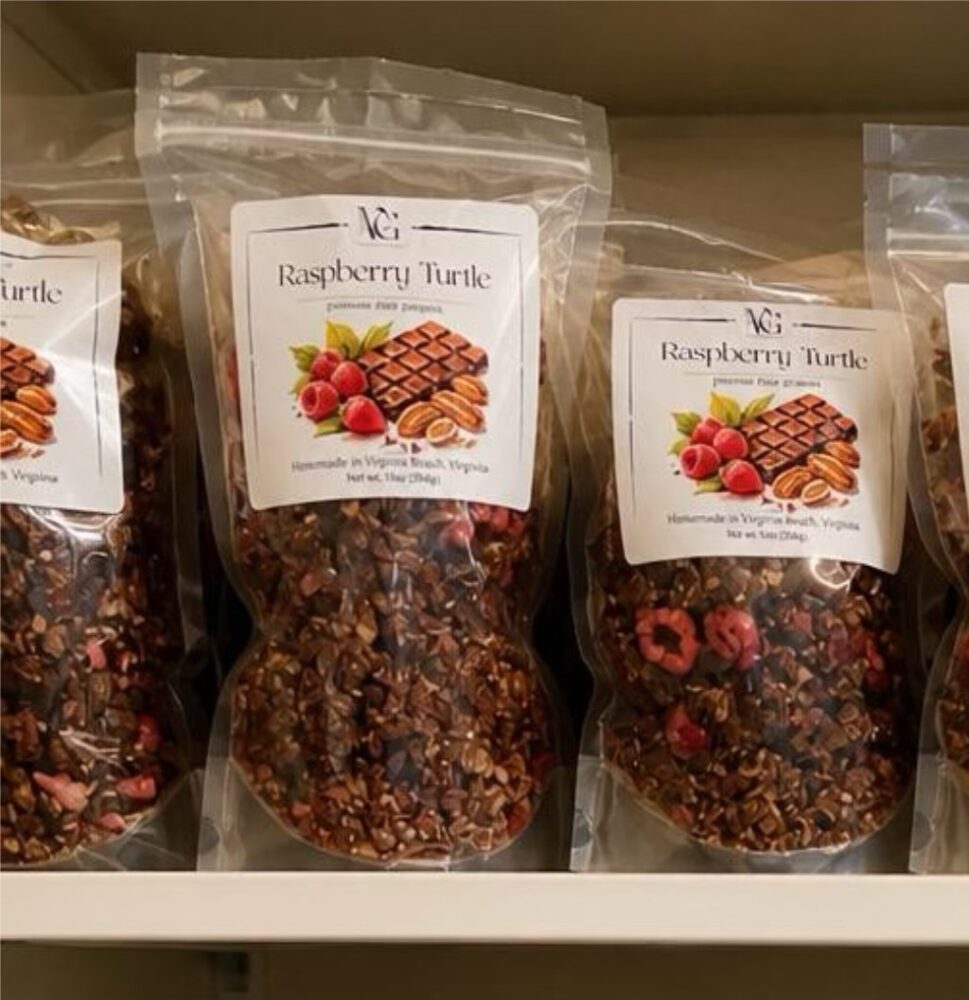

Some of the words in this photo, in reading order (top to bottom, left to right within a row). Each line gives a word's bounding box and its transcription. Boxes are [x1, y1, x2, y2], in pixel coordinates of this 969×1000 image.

[279, 258, 410, 290] Raspberry
[419, 261, 492, 290] Turtle
[0, 278, 62, 304] urtle
[661, 341, 791, 371] Raspberry
[801, 346, 868, 370] Turtle
